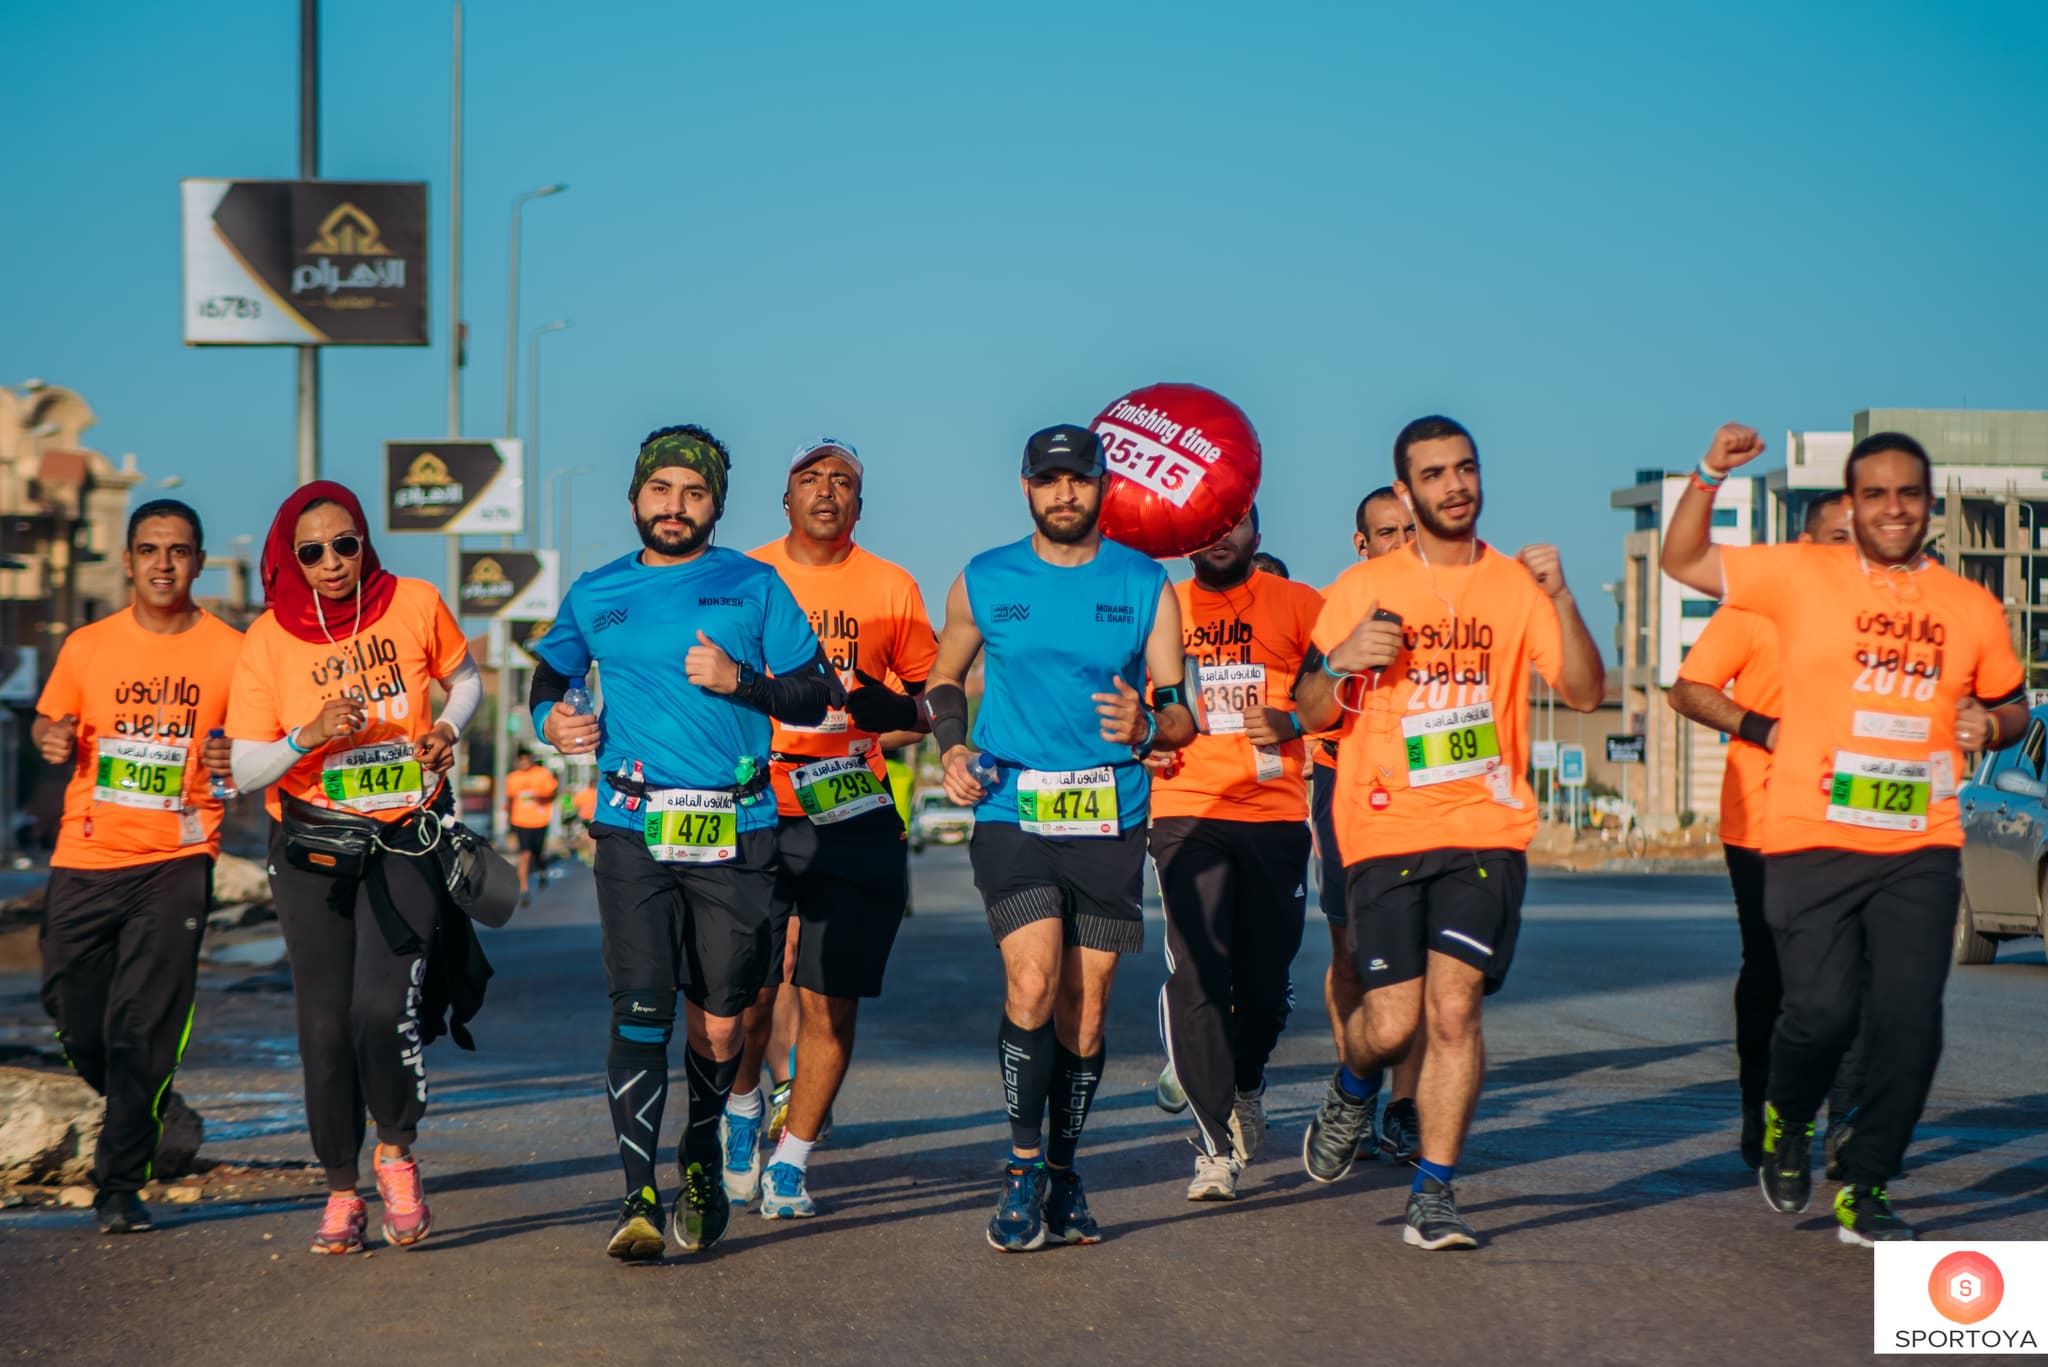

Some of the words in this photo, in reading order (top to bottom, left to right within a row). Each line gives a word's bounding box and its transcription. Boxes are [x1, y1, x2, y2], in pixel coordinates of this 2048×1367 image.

[1107, 400, 1182, 445] Finishing
[1178, 426, 1222, 464] time
[1100, 431, 1190, 491] 05:15
[1096, 603, 1134, 614] MOHAMED
[1096, 613, 1104, 622] EL
[1403, 617, 1493, 650] ماراثون
[1856, 611, 1946, 647] ماراثون
[312, 635, 397, 686] ماراثون
[1406, 653, 1490, 685] القاهرة
[115, 676, 200, 707] ماراثون
[115, 707, 197, 738] القاهرة
[1449, 729, 1478, 761] 89
[124, 762, 167, 793] 305
[359, 765, 404, 792] 447
[829, 772, 873, 804] 293
[1053, 790, 1099, 818] 474
[1870, 781, 1914, 812] 123
[647, 818, 659, 838] 42K
[678, 814, 721, 844] 473
